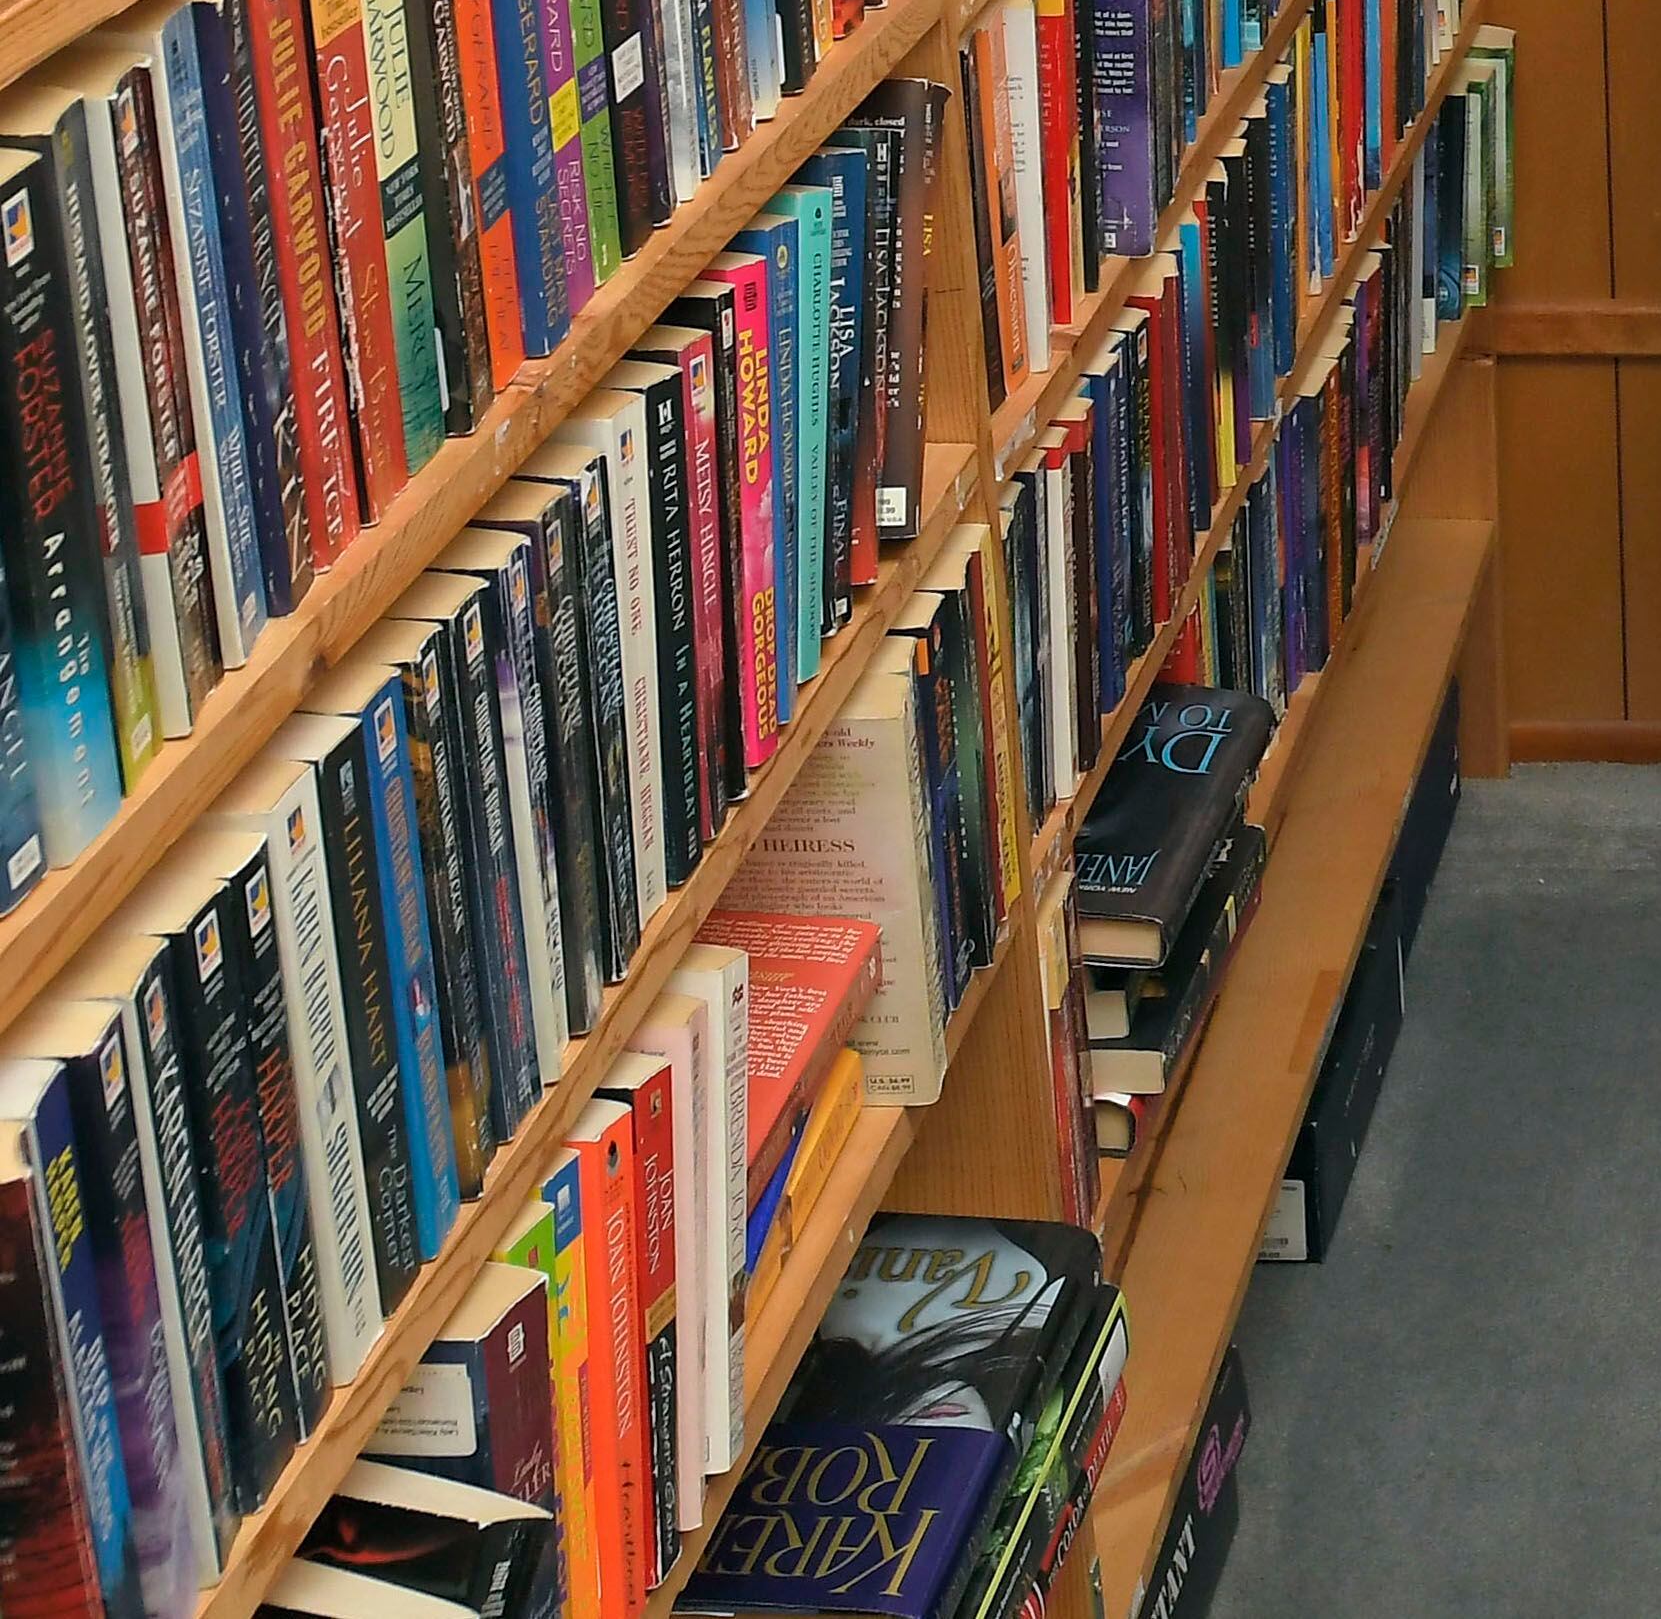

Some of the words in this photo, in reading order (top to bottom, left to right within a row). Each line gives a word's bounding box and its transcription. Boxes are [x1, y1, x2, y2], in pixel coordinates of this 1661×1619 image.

[382, 5, 410, 109] JULIE
[267, 16, 301, 132] JULIE
[285, 142, 328, 339] GARWOOD
[317, 54, 362, 240] Garwood
[344, 88, 372, 186] Julie
[127, 175, 157, 309] SUZANNE
[145, 321, 177, 461] FORSTER
[183, 168, 212, 296] SUZANNE
[199, 301, 227, 412] FORSTER
[13, 339, 56, 522] FORSTER
[36, 328, 72, 497] SUZANNE
[660, 464, 680, 520] RITA
[666, 530, 687, 631] HERRON
[674, 645, 690, 672] IN
[676, 682, 691, 698] A
[751, 592, 771, 740] GORGEOUS
[679, 704, 698, 823] HEARTBEAT
[342, 817, 373, 959] LILIANA
[361, 968, 388, 1066] HART
[151, 1052, 188, 1186] KAREN
[172, 1201, 211, 1359] HARPER
[392, 1163, 418, 1275] Darkest
[643, 1152, 666, 1277] JOHNSTON
[246, 1290, 284, 1438] HIDING
[295, 1243, 329, 1393] HIDING
